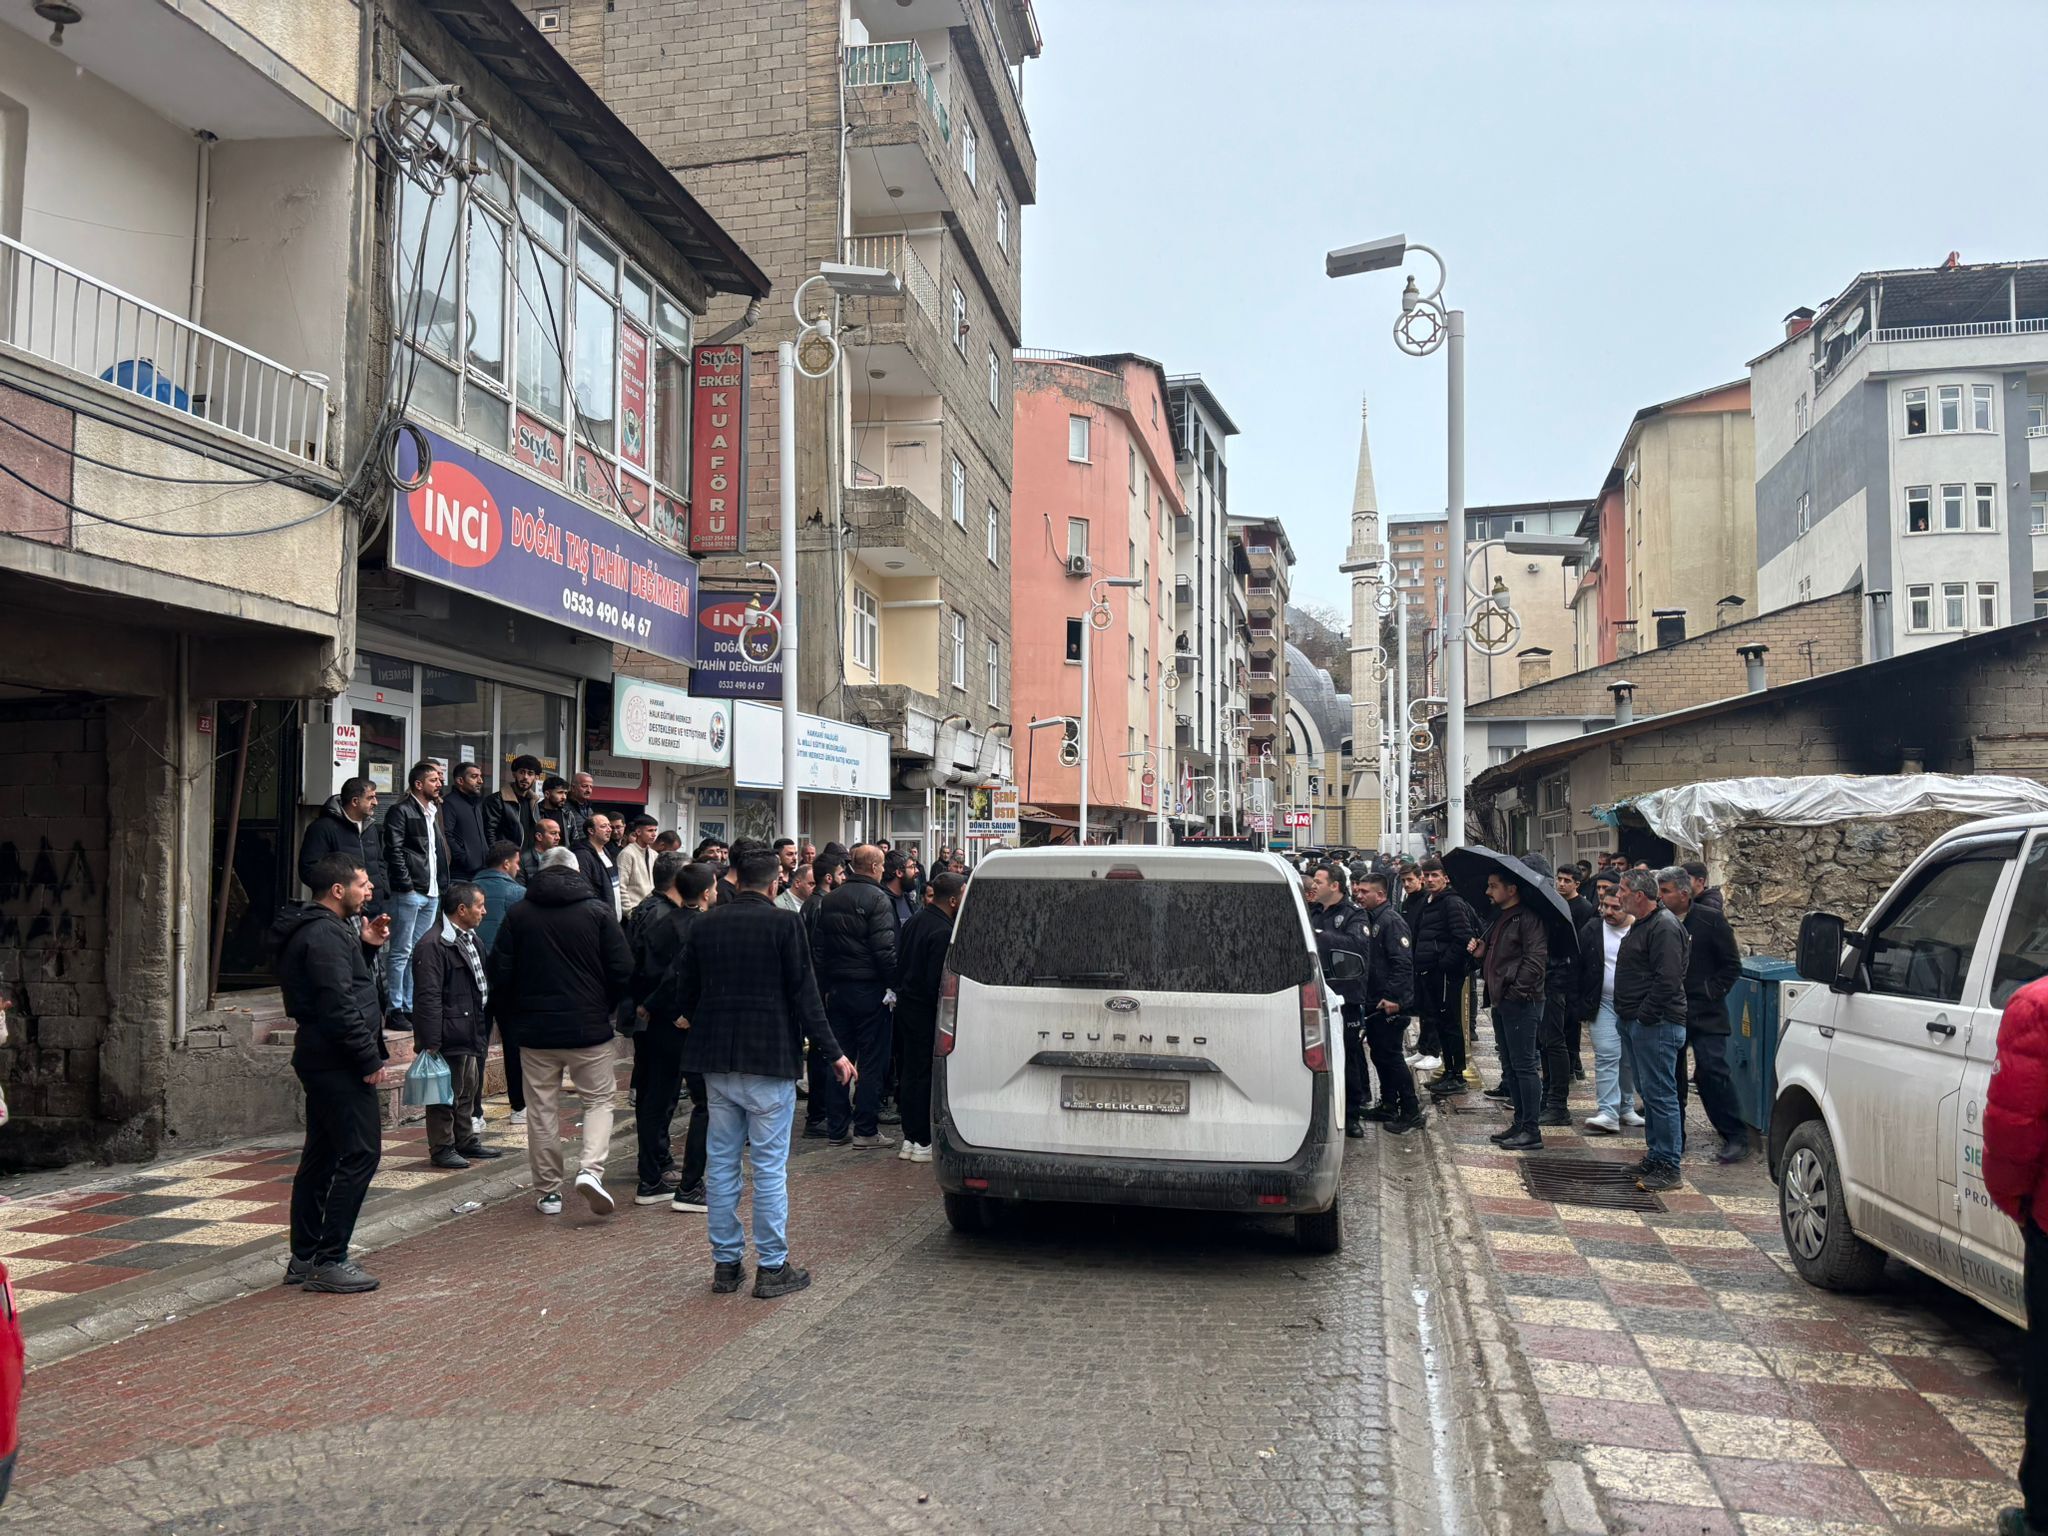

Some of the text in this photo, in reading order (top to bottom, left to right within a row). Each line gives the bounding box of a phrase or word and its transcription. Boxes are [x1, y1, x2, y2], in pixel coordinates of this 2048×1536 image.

[699, 375, 741, 387] ERKEK
[709, 392, 728, 533] KUAFÖRÜ
[512, 506, 690, 618] DOĞAL TAŞ TAHİN DEĞİRMENİ
[563, 588, 652, 638] 0533 490 64 67
[713, 610, 771, 627] İNİ
[714, 640, 742, 653] DOĞA
[697, 658, 726, 671] TAHİN
[719, 681, 733, 689] 0533
[735, 681, 747, 689] 490
[757, 682, 765, 690] 67
[337, 726, 356, 738] OVA
[649, 723, 677, 736] DESTEKLEME
[648, 736, 660, 746] KURS
[994, 790, 1017, 805] ŞERİF
[994, 807, 1016, 818] USTA
[969, 821, 1016, 830] DÖNER SALONU
[1111, 999, 1133, 1009] Ford
[1037, 1032, 1207, 1045] TOURNEO
